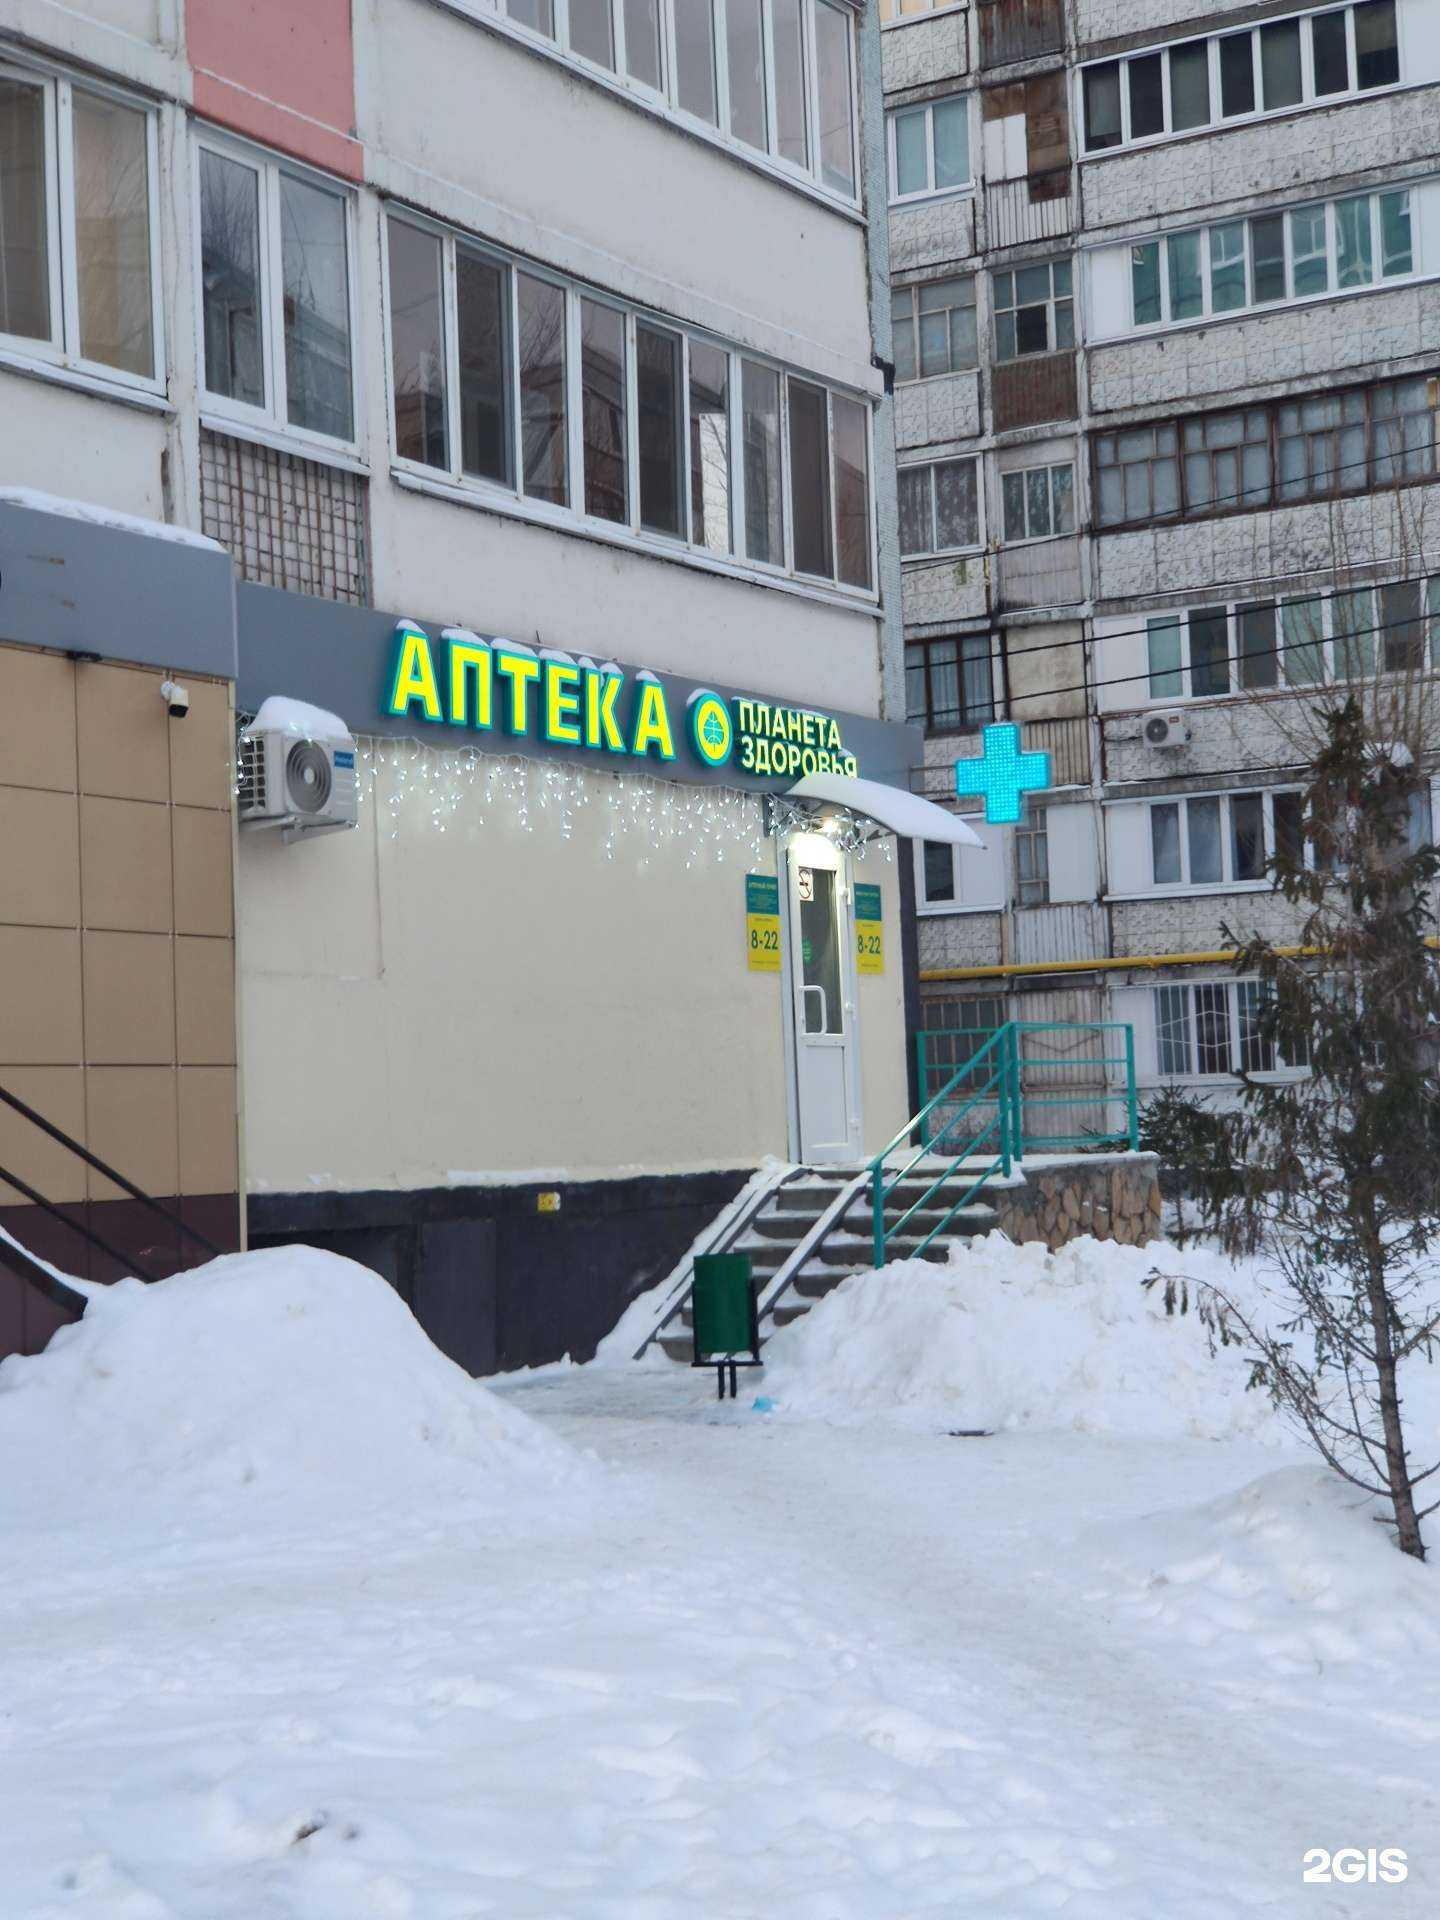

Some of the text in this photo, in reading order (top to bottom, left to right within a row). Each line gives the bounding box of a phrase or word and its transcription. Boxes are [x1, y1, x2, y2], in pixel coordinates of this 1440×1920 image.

[389, 629, 677, 760] АПТЕКА
[739, 701, 842, 750] ПЛАНЕТА
[741, 735, 858, 779] ЗДОРОВЬЯ
[751, 929, 779, 950] 8-22
[857, 935, 881, 954] 8-22
